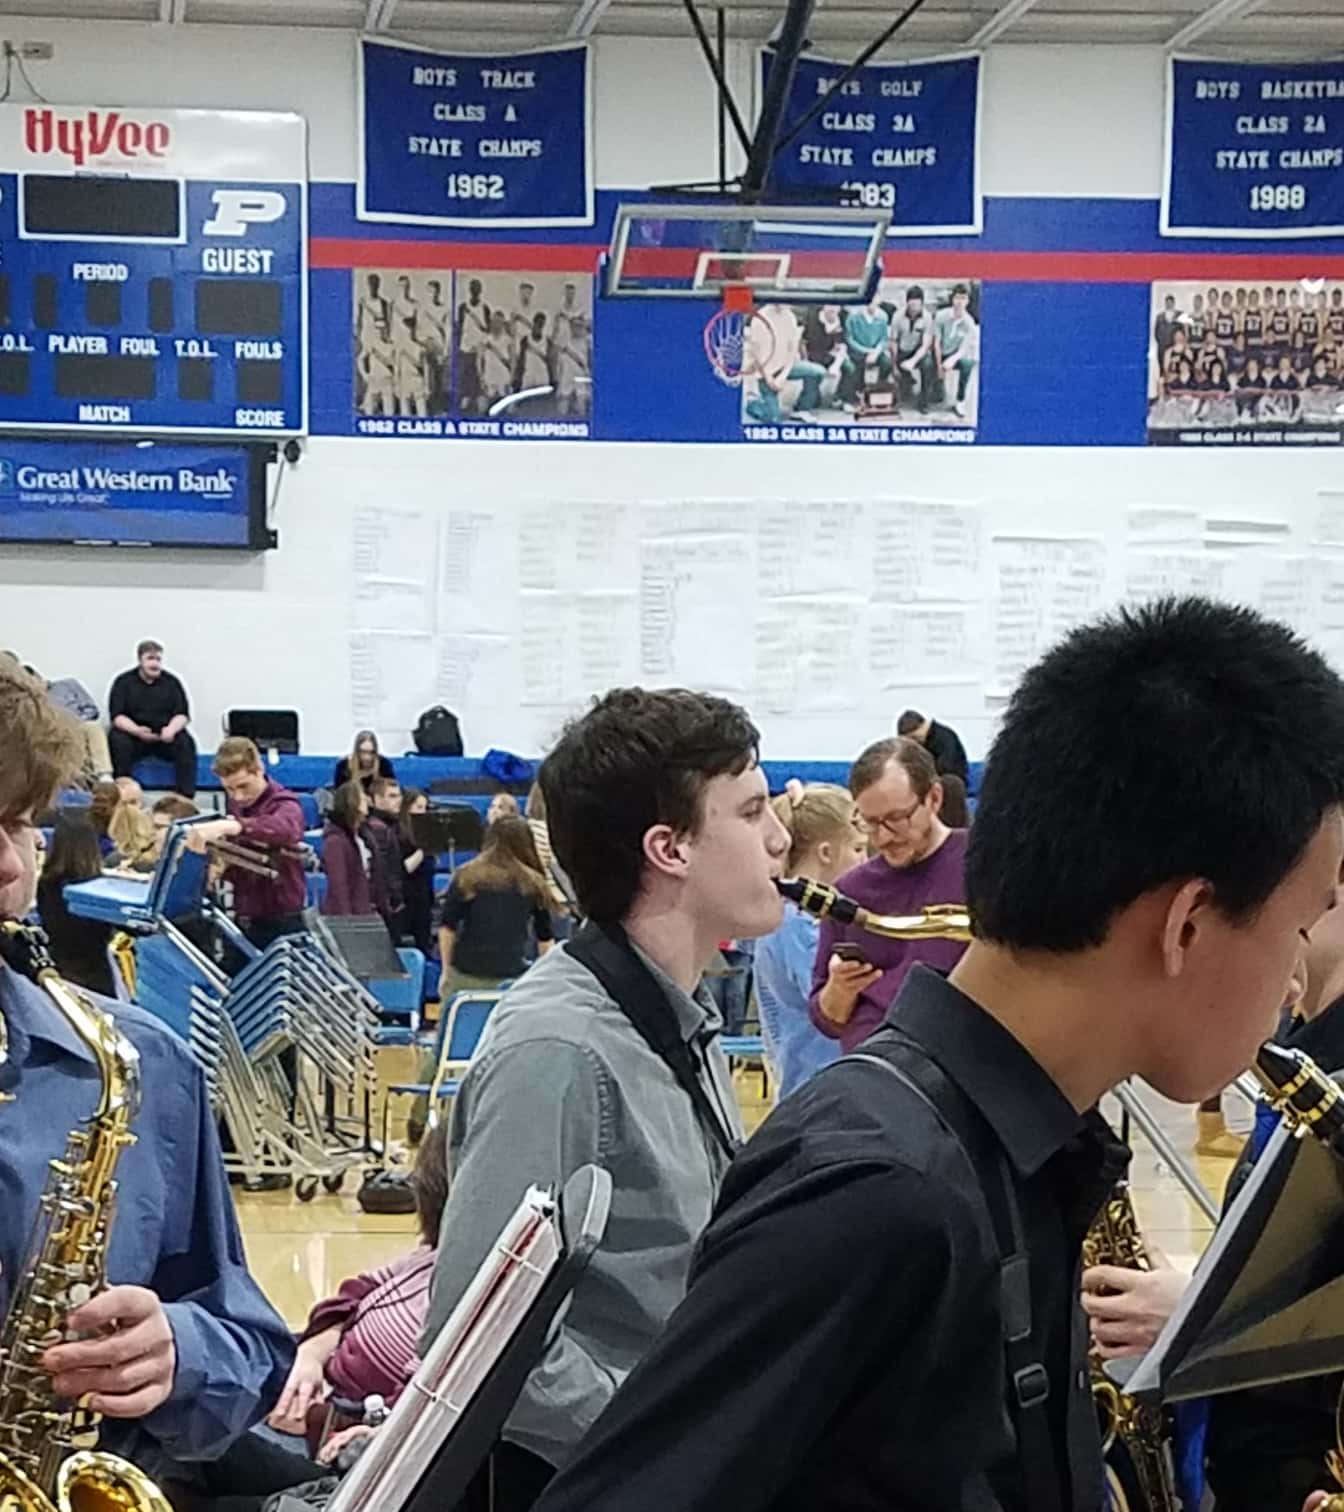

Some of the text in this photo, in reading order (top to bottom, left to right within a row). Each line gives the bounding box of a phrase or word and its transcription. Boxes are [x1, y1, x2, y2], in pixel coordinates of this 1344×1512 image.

[413, 66, 536, 88] BOYS TRACK
[881, 80, 923, 97] GOLF
[1196, 80, 1240, 99] BOYS
[433, 103, 517, 122] CLASS A
[822, 112, 915, 132] CLASS 3A
[1236, 115, 1326, 134] CLASS 2A
[408, 136, 543, 158] STATE CHAMPS
[800, 144, 937, 167] STATE CHAMPS
[1216, 148, 1344, 169] STATE CHAMPS
[447, 173, 505, 199] 1962
[1249, 184, 1306, 211] 1988
[202, 190, 287, 237] P
[202, 248, 274, 274] GUEST
[73, 263, 129, 282] PERIOD
[49, 335, 160, 355] PLAYER FOUL
[235, 341, 283, 360] FOULS
[79, 405, 131, 423] MATCH
[236, 408, 286, 427] SCORE
[398, 420, 442, 435] CLASS
[445, 421, 457, 435] A
[458, 421, 500, 436] STATE
[503, 422, 589, 437] CHAMPIONS
[781, 427, 824, 441] CLASS
[849, 428, 890, 442] STATE
[892, 429, 976, 443] CHAMPIONS
[17, 466, 79, 490] Great
[82, 467, 174, 492] Western
[179, 469, 234, 493] Bank
